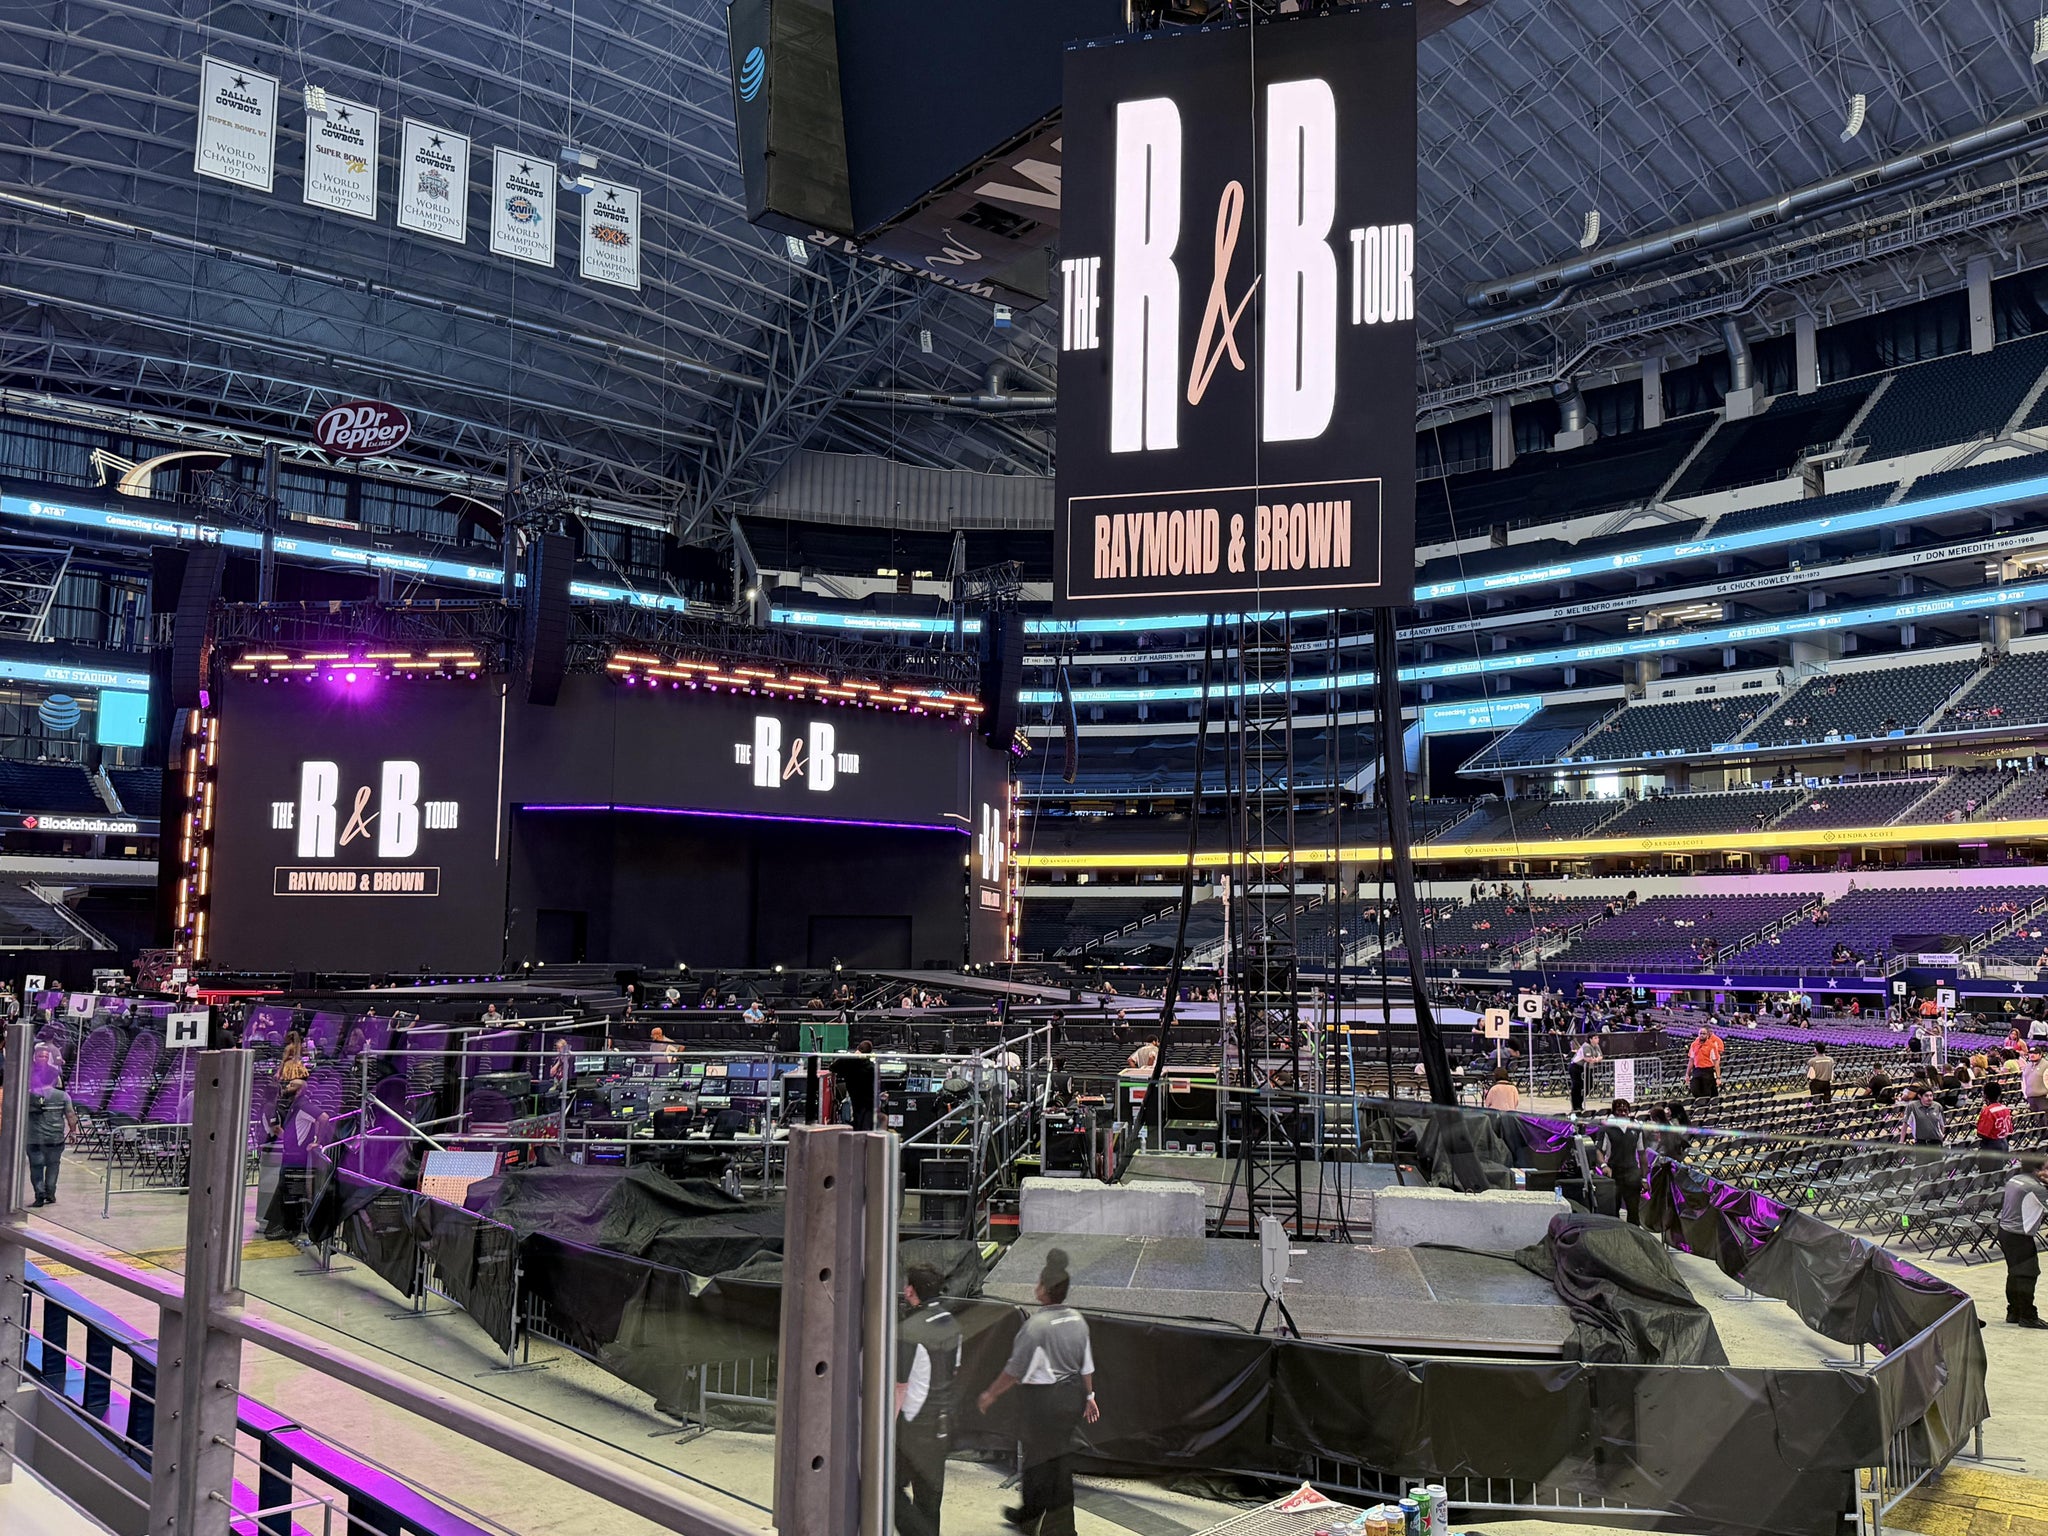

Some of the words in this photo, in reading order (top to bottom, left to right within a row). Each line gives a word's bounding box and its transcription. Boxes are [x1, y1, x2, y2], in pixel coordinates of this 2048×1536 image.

[221, 88, 258, 106] DALLAS
[216, 96, 262, 117] COWBOYS
[207, 115, 233, 128] SUPER
[234, 123, 257, 134] BOWL
[326, 120, 361, 136] DALLAS
[321, 128, 364, 146] COWBOYS
[216, 142, 255, 161] WORLD
[315, 144, 342, 158] SUPER
[343, 150, 369, 166] BOWL
[419, 147, 452, 163] DALLAS
[203, 149, 267, 175] CHAMPIONS
[415, 155, 456, 173] COWBOYS
[223, 165, 246, 179] 1971
[323, 172, 360, 190] WORLD
[510, 174, 540, 189] DALLAS
[311, 180, 370, 203] CHAMPIONS
[505, 182, 544, 198] COWBOYS
[330, 195, 352, 208] 1977
[416, 198, 450, 214] WORLD
[597, 201, 626, 215] DALLAS
[404, 205, 461, 227] CHAMPIONS
[593, 208, 629, 223] COWBOYS
[422, 219, 443, 232] 1992
[507, 223, 540, 239] WORLD
[497, 230, 549, 251] CHAMPIONS
[513, 244, 533, 256] 1993
[596, 249, 626, 264] WORLD
[586, 256, 636, 275] CHAMPIONS
[602, 269, 620, 280] 1995
[1061, 256, 1101, 351] THE
[1349, 223, 1415, 325] TOUR
[353, 407, 389, 429] Dr
[318, 408, 405, 450] Pepper
[42, 507, 66, 518] AT&T
[105, 514, 153, 531] Connecting
[276, 540, 297, 551] AT&T
[1094, 507, 1220, 579] RAYMOND
[1227, 513, 1247, 574] &
[1254, 500, 1352, 572] BROWN
[1912, 554, 1922, 562] 17
[1926, 550, 1945, 560] DON
[1948, 542, 1995, 556] MEREDITH
[476, 570, 495, 580] AT&T
[1717, 585, 1727, 593] 54
[1730, 581, 1756, 590] CHUCK
[1758, 575, 1791, 586] HOWLEY
[1566, 606, 1580, 615] MEL
[1582, 602, 1611, 613] RENFRO
[1895, 606, 1916, 616] AT&T
[1917, 601, 1954, 612] STADIUM
[2007, 591, 2025, 599] AT&T
[1409, 627, 1432, 636] RANDY
[1434, 624, 1456, 633] WHITE
[1728, 629, 1745, 639] AT&T
[1746, 625, 1780, 636] STADIUM
[1827, 616, 1842, 625] AT&T
[44, 669, 70, 679] AT&T
[71, 671, 118, 684] STADIUM
[734, 743, 752, 764] THE
[754, 715, 835, 792] R&B
[837, 753, 860, 774] TOUR
[272, 802, 295, 829] THE
[298, 760, 420, 858] R&B
[424, 801, 459, 829] TOUR
[38, 817, 137, 833] Blockchain.com
[288, 871, 357, 891] RAYMOND
[359, 873, 370, 891] &
[373, 871, 425, 891] BROWN
[29, 978, 41, 989] K
[1897, 984, 1903, 992] E
[76, 998, 88, 1012] J
[1523, 999, 1537, 1013] G
[1942, 993, 1950, 1004] F
[174, 1020, 198, 1041] H
[1494, 1015, 1504, 1031] P
